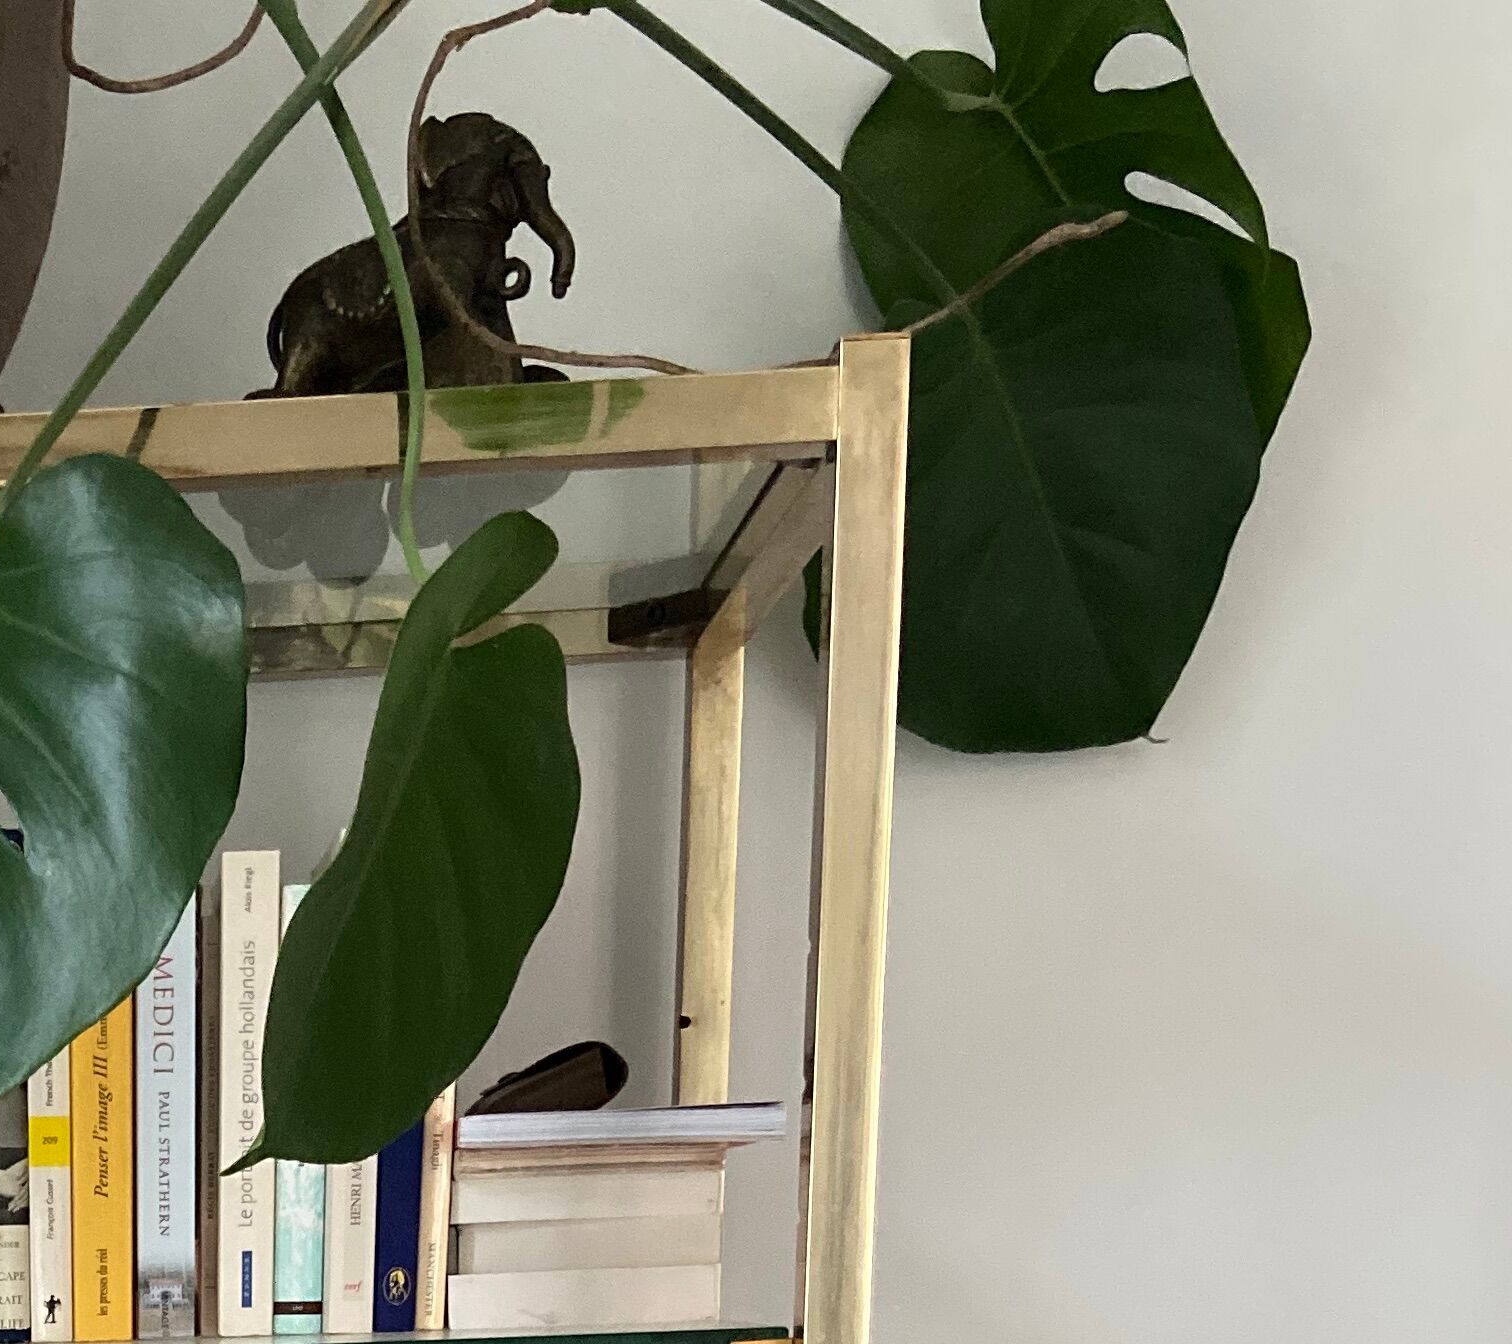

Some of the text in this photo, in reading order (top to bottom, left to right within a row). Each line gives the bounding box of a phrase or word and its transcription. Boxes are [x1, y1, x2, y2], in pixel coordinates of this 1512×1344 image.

[152, 957, 174, 1073] MEDICI
[237, 938, 256, 1034] hollandais
[91, 1053, 108, 1079] III
[240, 1038, 259, 1104] groupe
[92, 1081, 114, 1142] l'image
[238, 1108, 254, 1131] de
[92, 1146, 109, 1198] Penser
[154, 1090, 174, 1237] PAUL STRATHERN
[237, 1207, 254, 1228] Le
